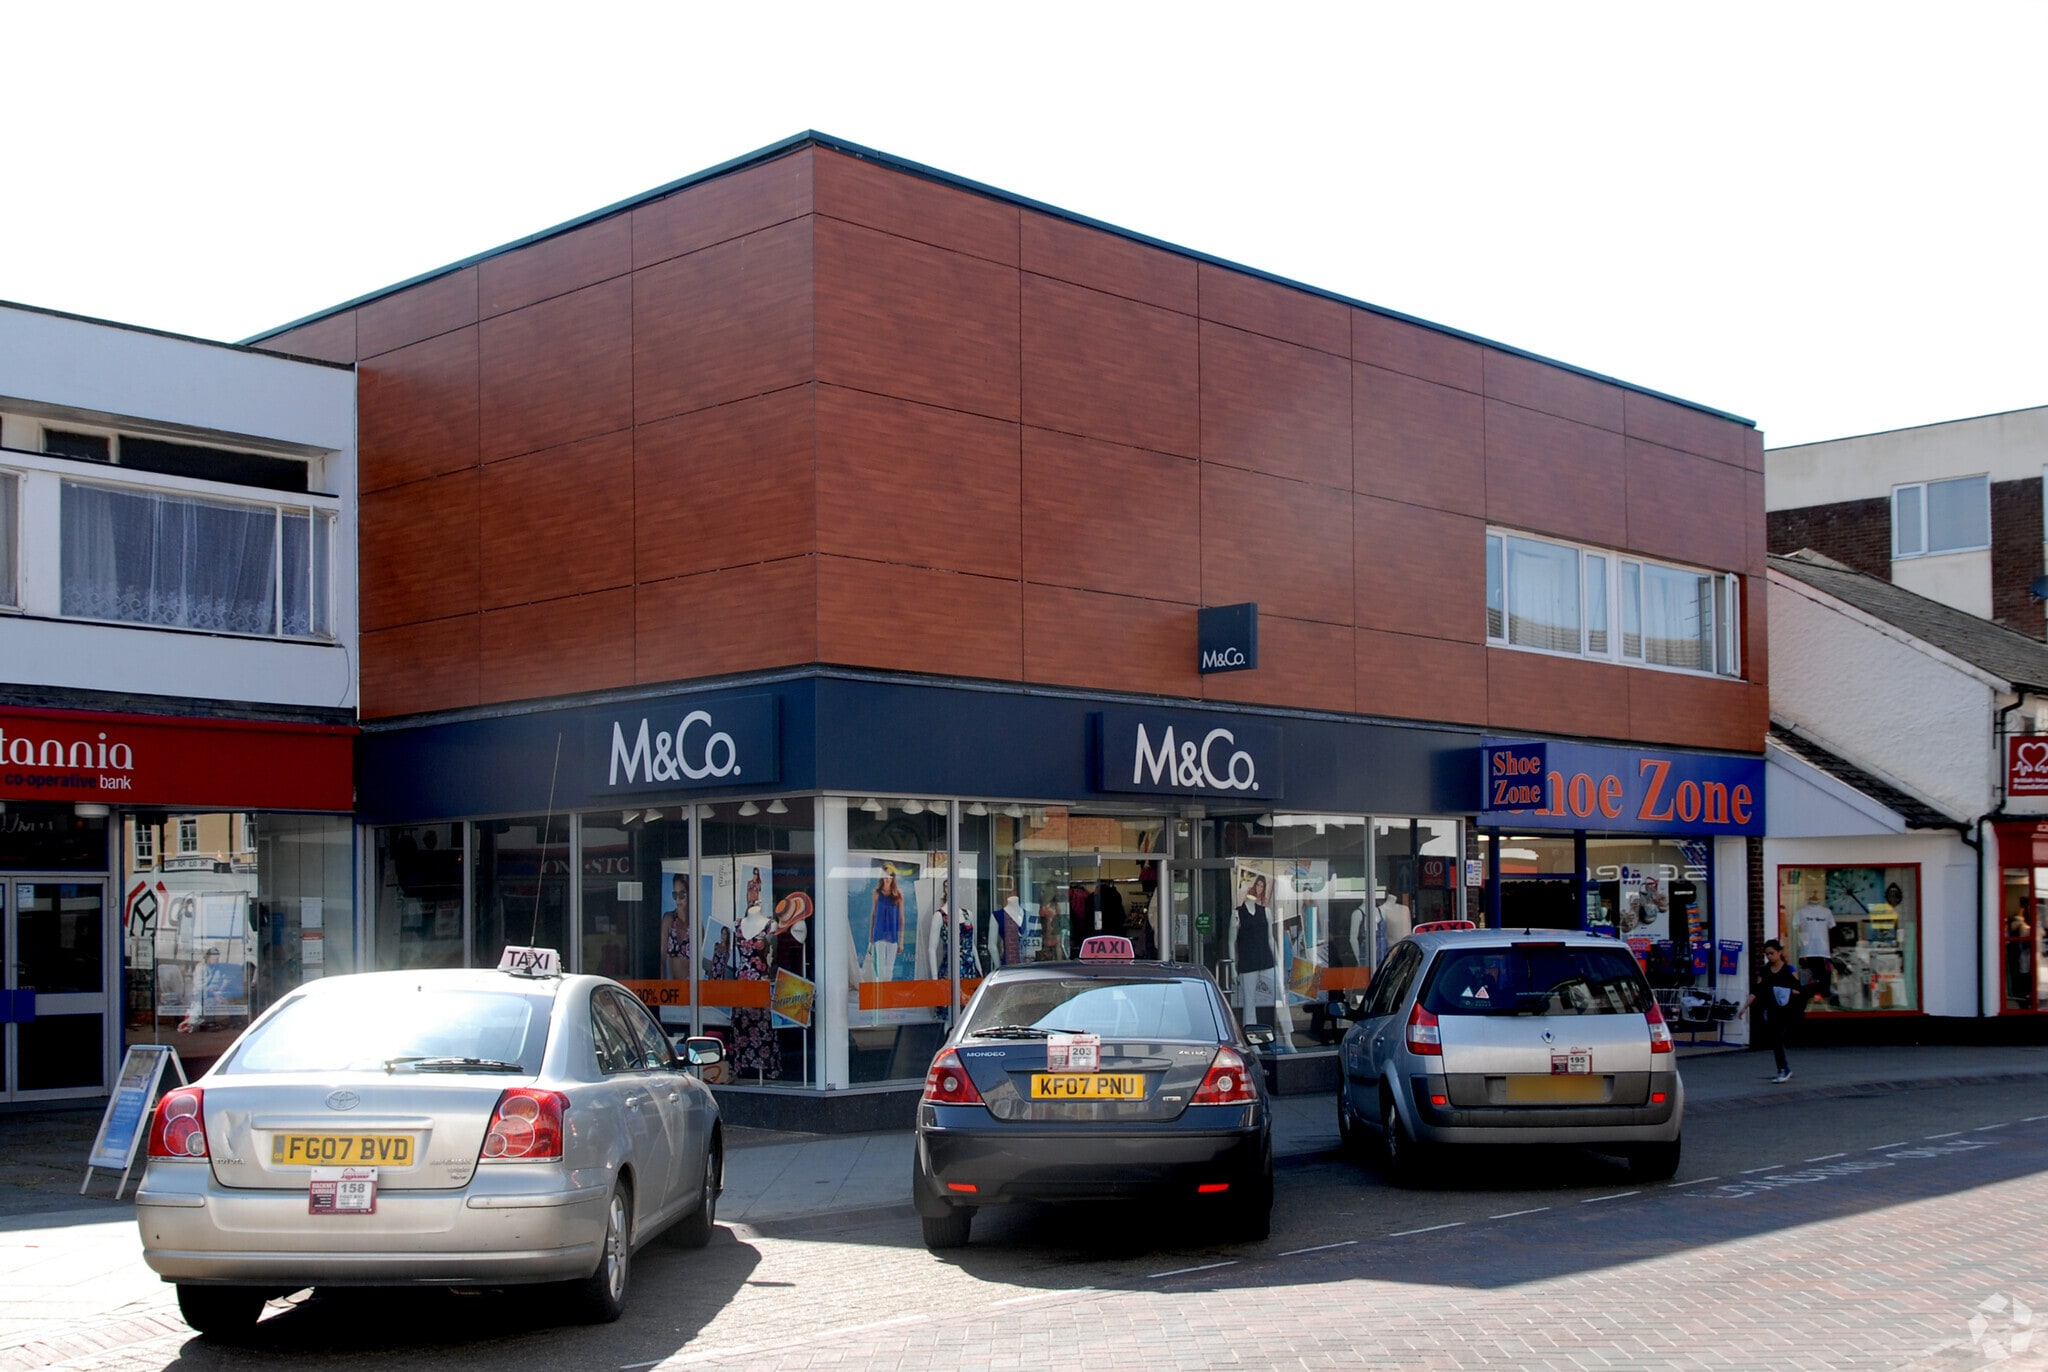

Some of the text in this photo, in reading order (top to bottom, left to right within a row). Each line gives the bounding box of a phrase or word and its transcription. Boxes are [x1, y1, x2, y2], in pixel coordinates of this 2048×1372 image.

[1202, 647, 1246, 669] M&Co.
[609, 710, 741, 786] M&Co.
[1133, 723, 1259, 791] M&Co.
[1493, 751, 1541, 776] Shoe
[5, 773, 132, 790] co-operative bank
[1493, 779, 1541, 805] Zone
[1506, 758, 1752, 825] hoe Zone
[1088, 941, 1125, 954] TAXI
[508, 950, 550, 970] TAXI
[660, 988, 679, 1003] OFF
[1072, 1047, 1092, 1056] 203
[1041, 1077, 1135, 1095] KF07 PNU
[289, 1137, 408, 1160] FG07 BVD
[341, 1183, 365, 1193] 158
